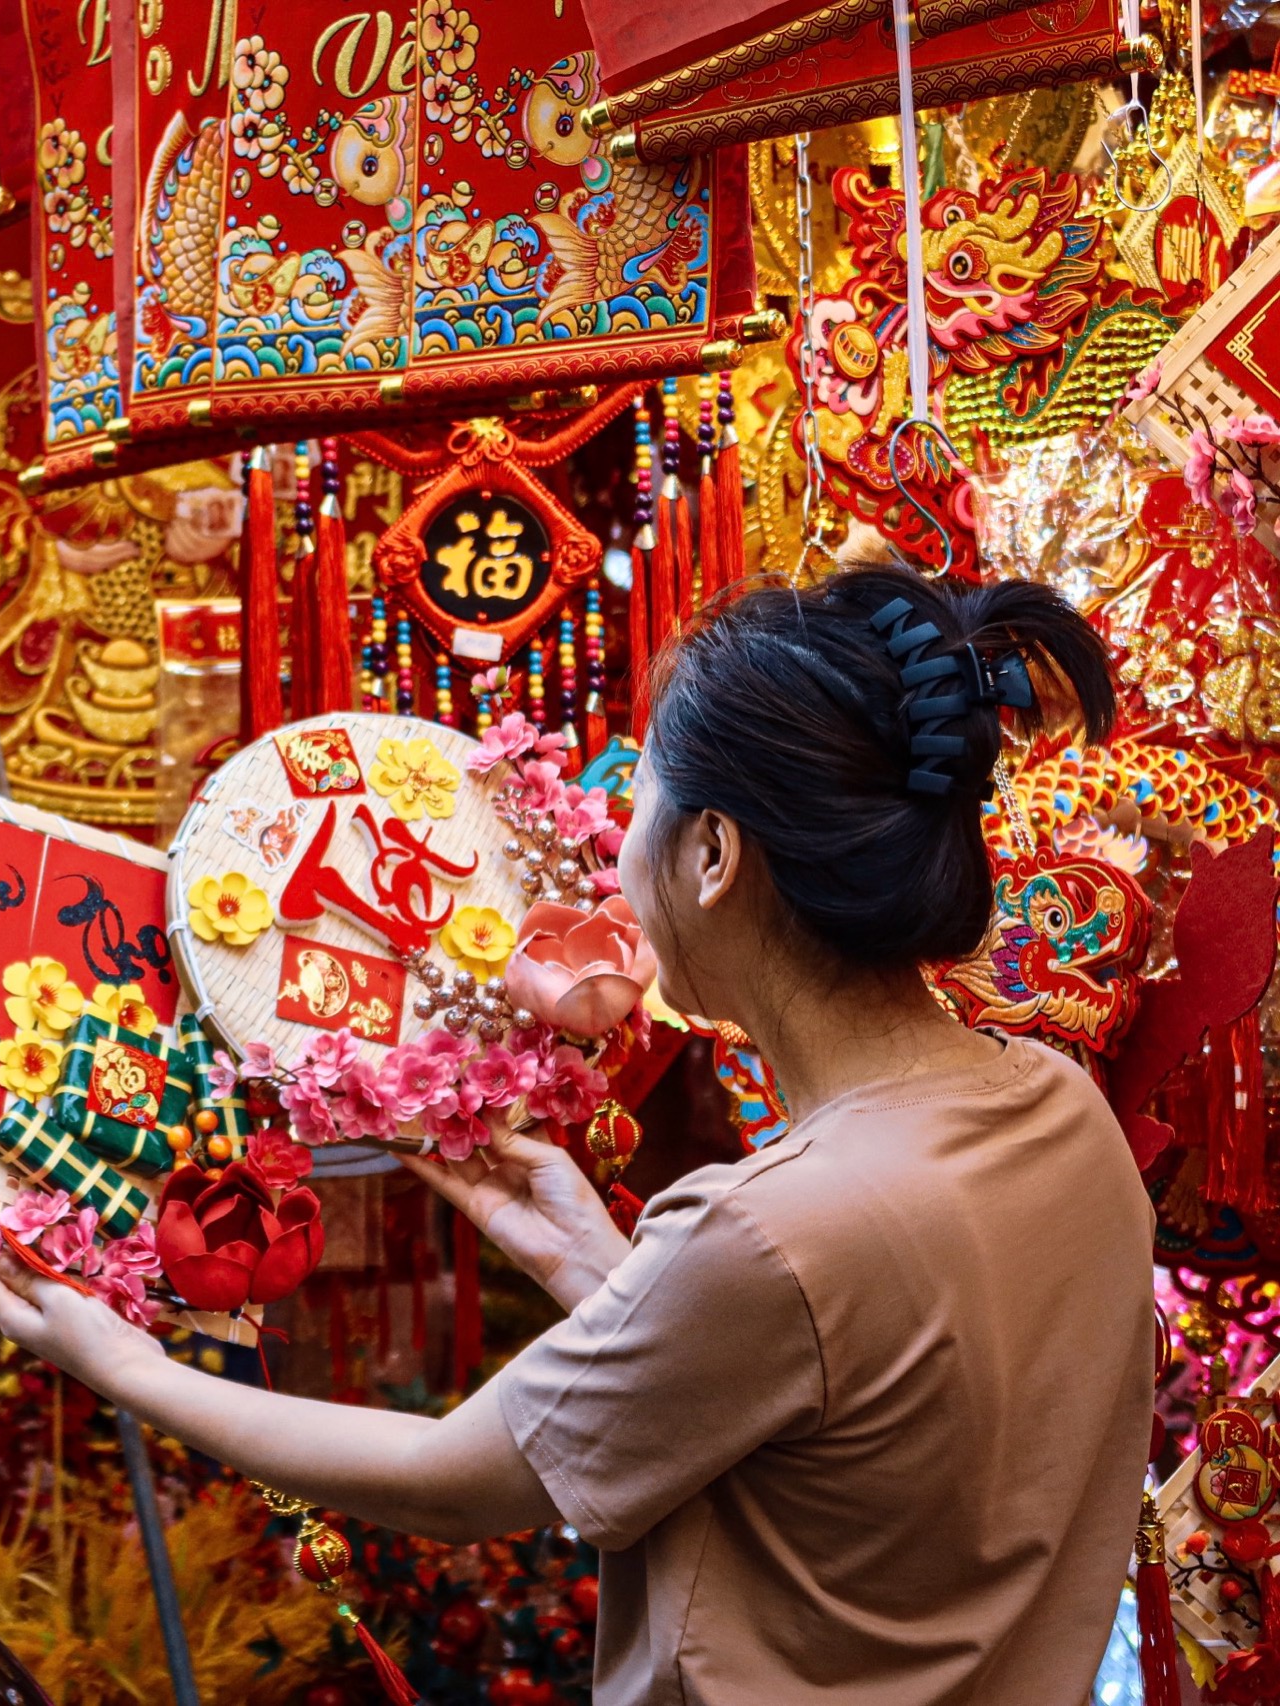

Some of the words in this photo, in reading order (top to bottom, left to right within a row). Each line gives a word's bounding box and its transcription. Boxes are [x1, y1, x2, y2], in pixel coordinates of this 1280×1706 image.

[436, 509, 533, 601] 福
[53, 873, 172, 987] Thọ
[278, 799, 479, 958] Tết
[96, 1047, 147, 1100] 福
